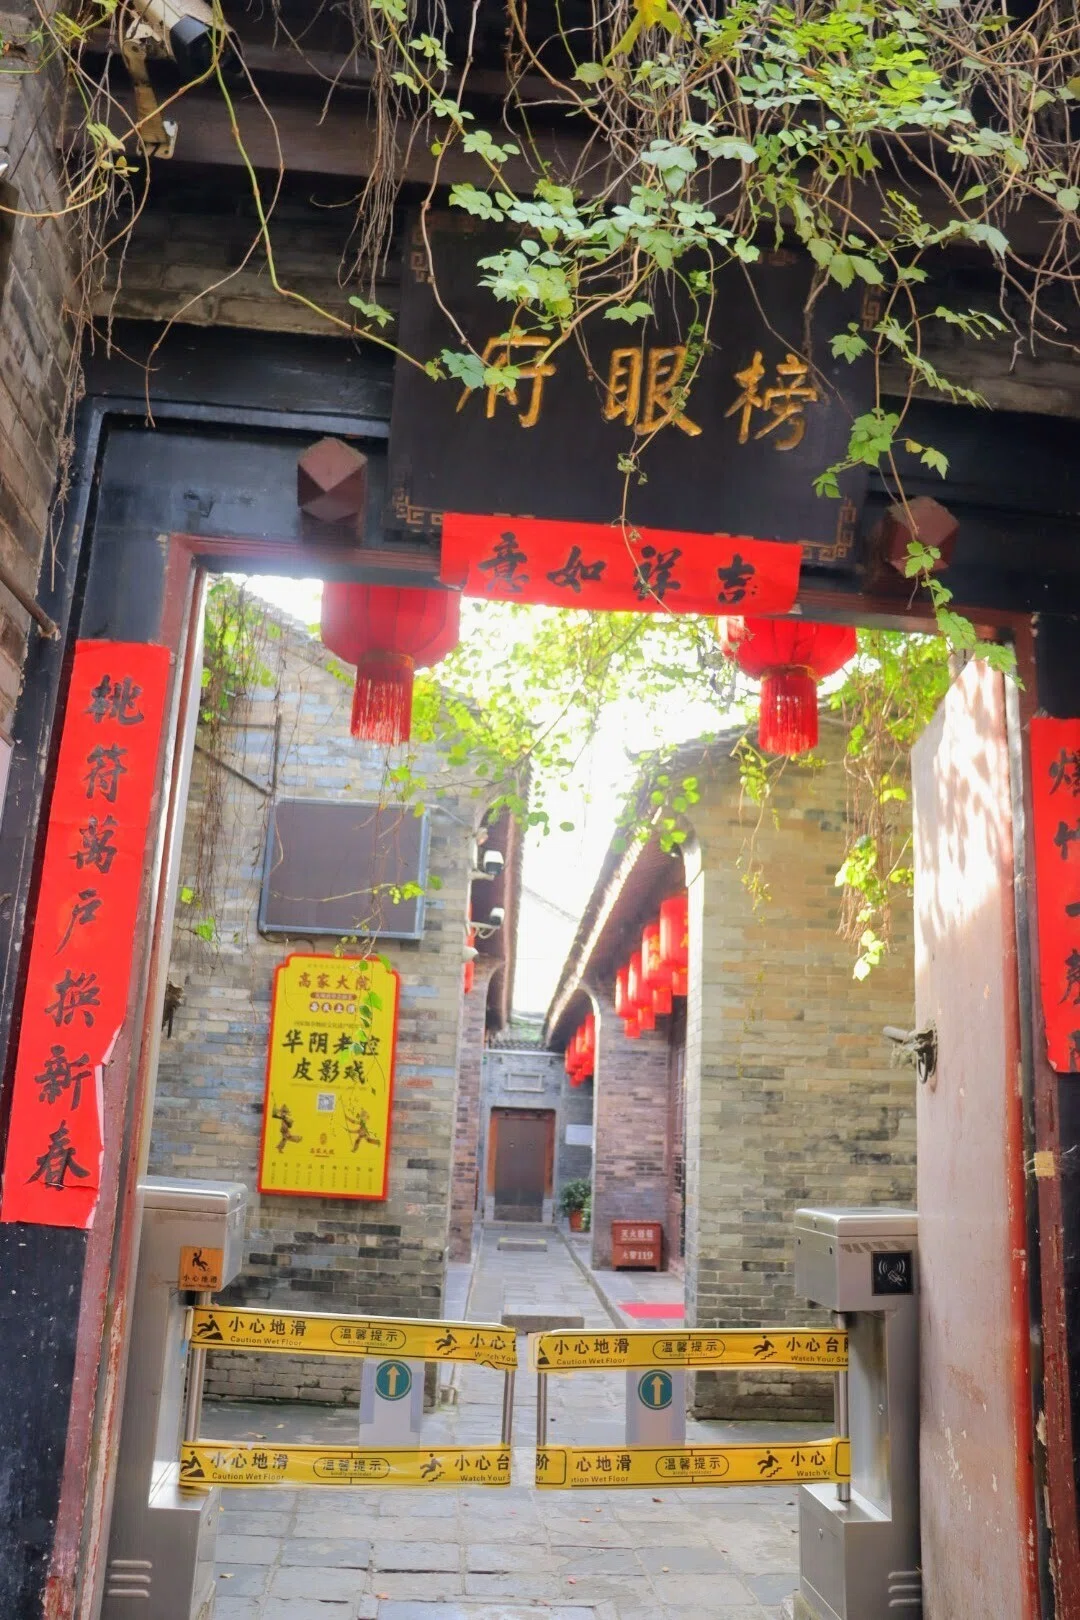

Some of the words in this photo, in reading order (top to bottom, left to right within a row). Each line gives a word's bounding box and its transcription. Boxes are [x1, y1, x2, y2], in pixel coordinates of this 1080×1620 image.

[478, 531, 758, 605] 吉祥如意
[298, 971, 371, 991] 高家大院
[292, 1057, 365, 1084] 皮影戏
[623, 1250, 653, 1260] 火警119
[228, 1316, 307, 1337] 小心地滑
[230, 1335, 263, 1345] Caution
[264, 1337, 279, 1346] Wet
[281, 1338, 302, 1347] Floor
[340, 1327, 398, 1343] 温馨提示
[554, 1338, 629, 1355] 小心地滑
[661, 1341, 717, 1353] 温馨提示
[606, 1356, 626, 1364] Floor
[210, 1451, 289, 1471] 小心地滑
[322, 1459, 382, 1472] 温馨提示
[664, 1457, 721, 1470] 温馨提示
[790, 1450, 826, 1467] 小心
[212, 1471, 243, 1480] Caution
[263, 1473, 284, 1481] Floor
[591, 1475, 607, 1483] Wet
